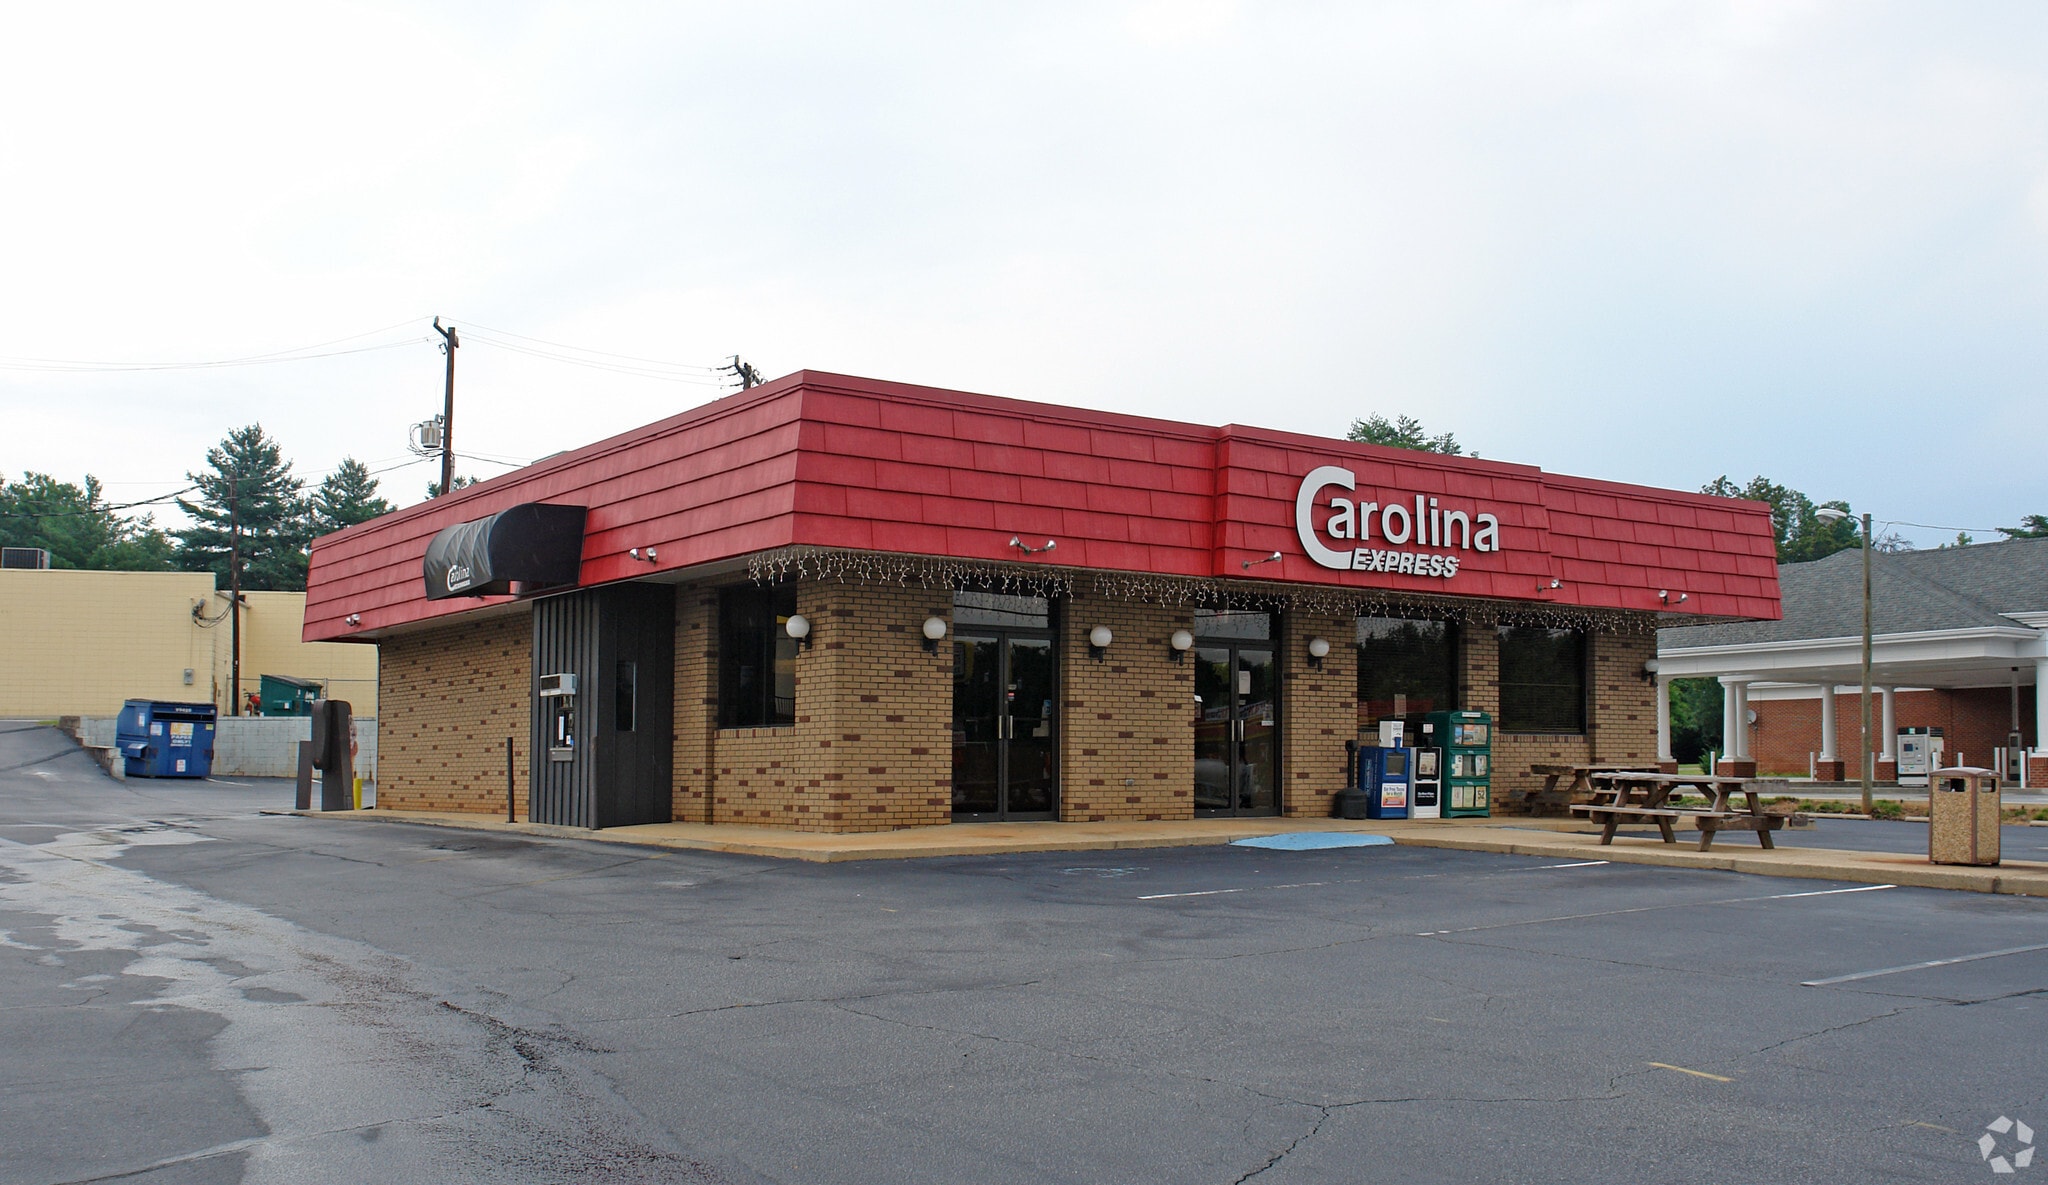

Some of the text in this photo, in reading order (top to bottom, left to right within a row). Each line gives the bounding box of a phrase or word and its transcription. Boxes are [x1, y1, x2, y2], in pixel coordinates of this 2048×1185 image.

[1296, 465, 1500, 570] Carolina
[447, 565, 470, 591] Carolina
[1352, 548, 1459, 578] EXPRESS
